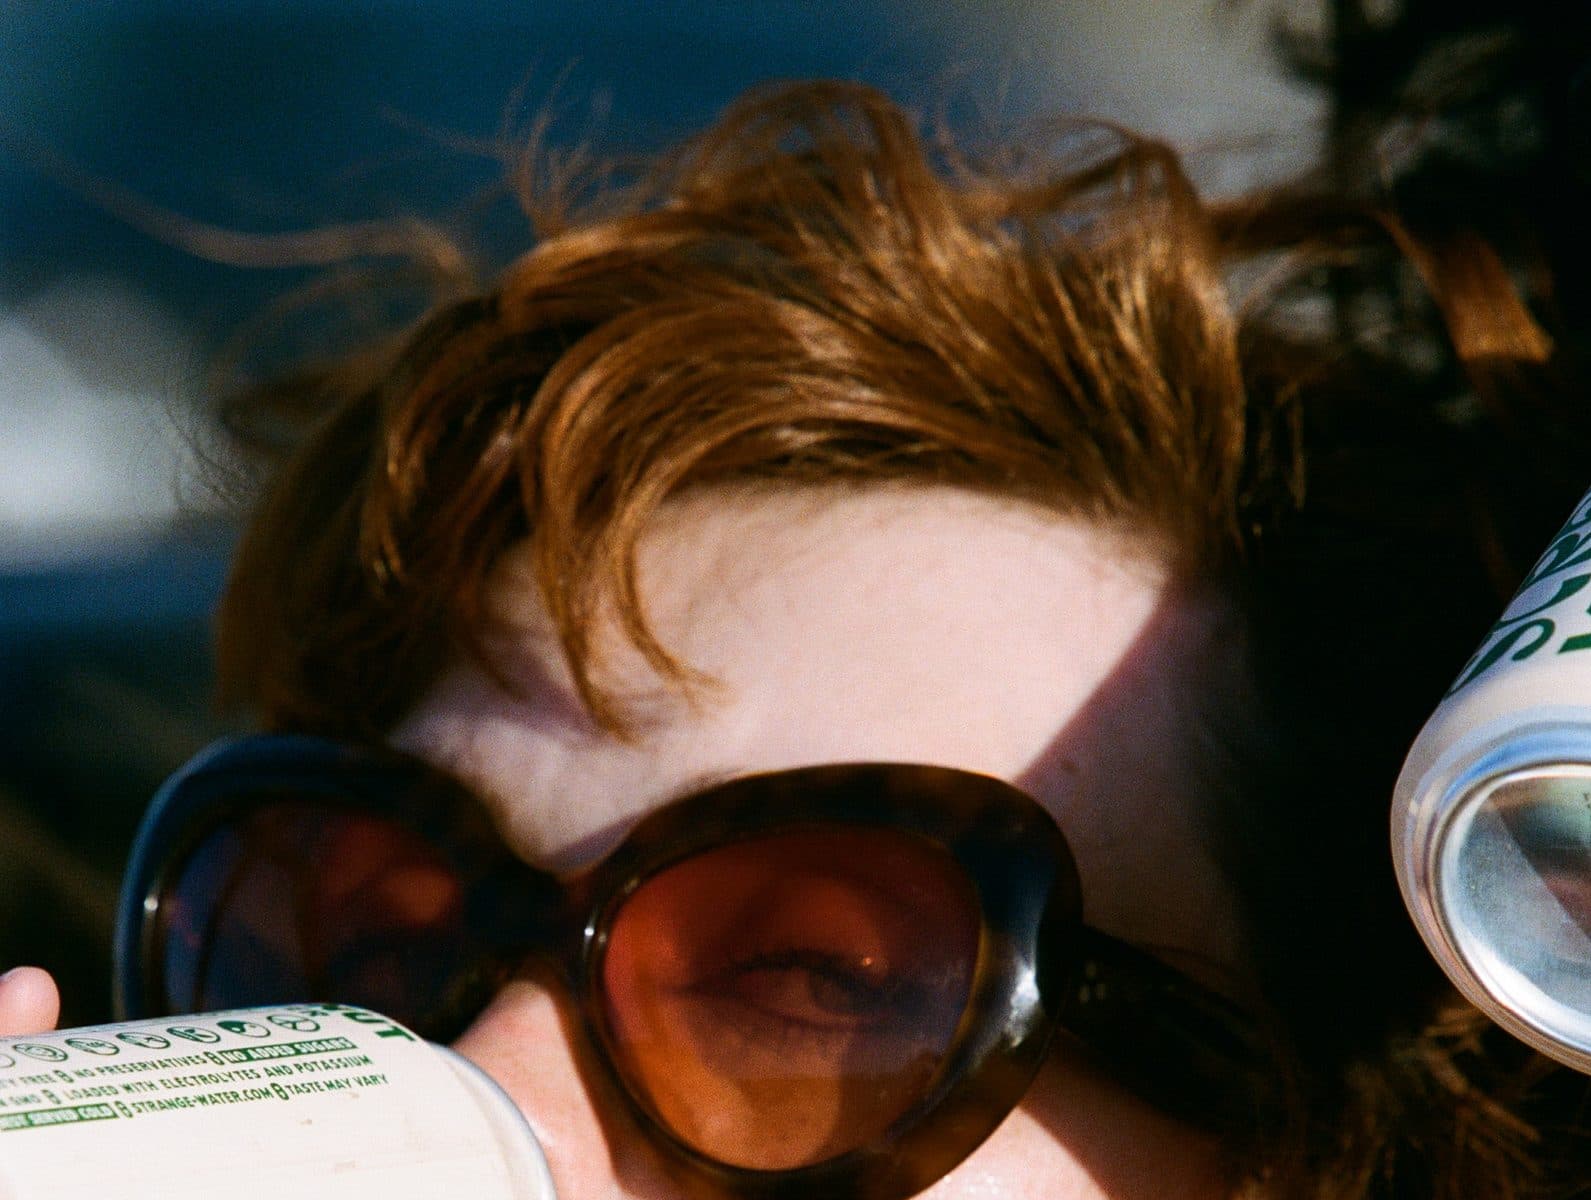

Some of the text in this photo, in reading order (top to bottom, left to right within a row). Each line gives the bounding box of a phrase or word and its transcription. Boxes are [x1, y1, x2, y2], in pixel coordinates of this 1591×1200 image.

[63, 1085, 119, 1101] LOADED
[121, 1079, 159, 1094] WITH
[159, 1068, 262, 1090] ELECTROLYTES
[262, 1064, 295, 1079] AND
[293, 1053, 374, 1074] POTASSIUM
[73, 1068, 96, 1079] NO
[95, 1054, 208, 1076] PRESERVATIVES
[221, 1050, 248, 1065] NO
[247, 1043, 297, 1060] ADDED
[296, 1037, 354, 1054] SUGARS
[131, 1086, 274, 1114] STRANGE-WATER.COM
[287, 1080, 326, 1097] TASTE
[324, 1076, 354, 1091] MAY
[350, 1072, 390, 1090] VARY
